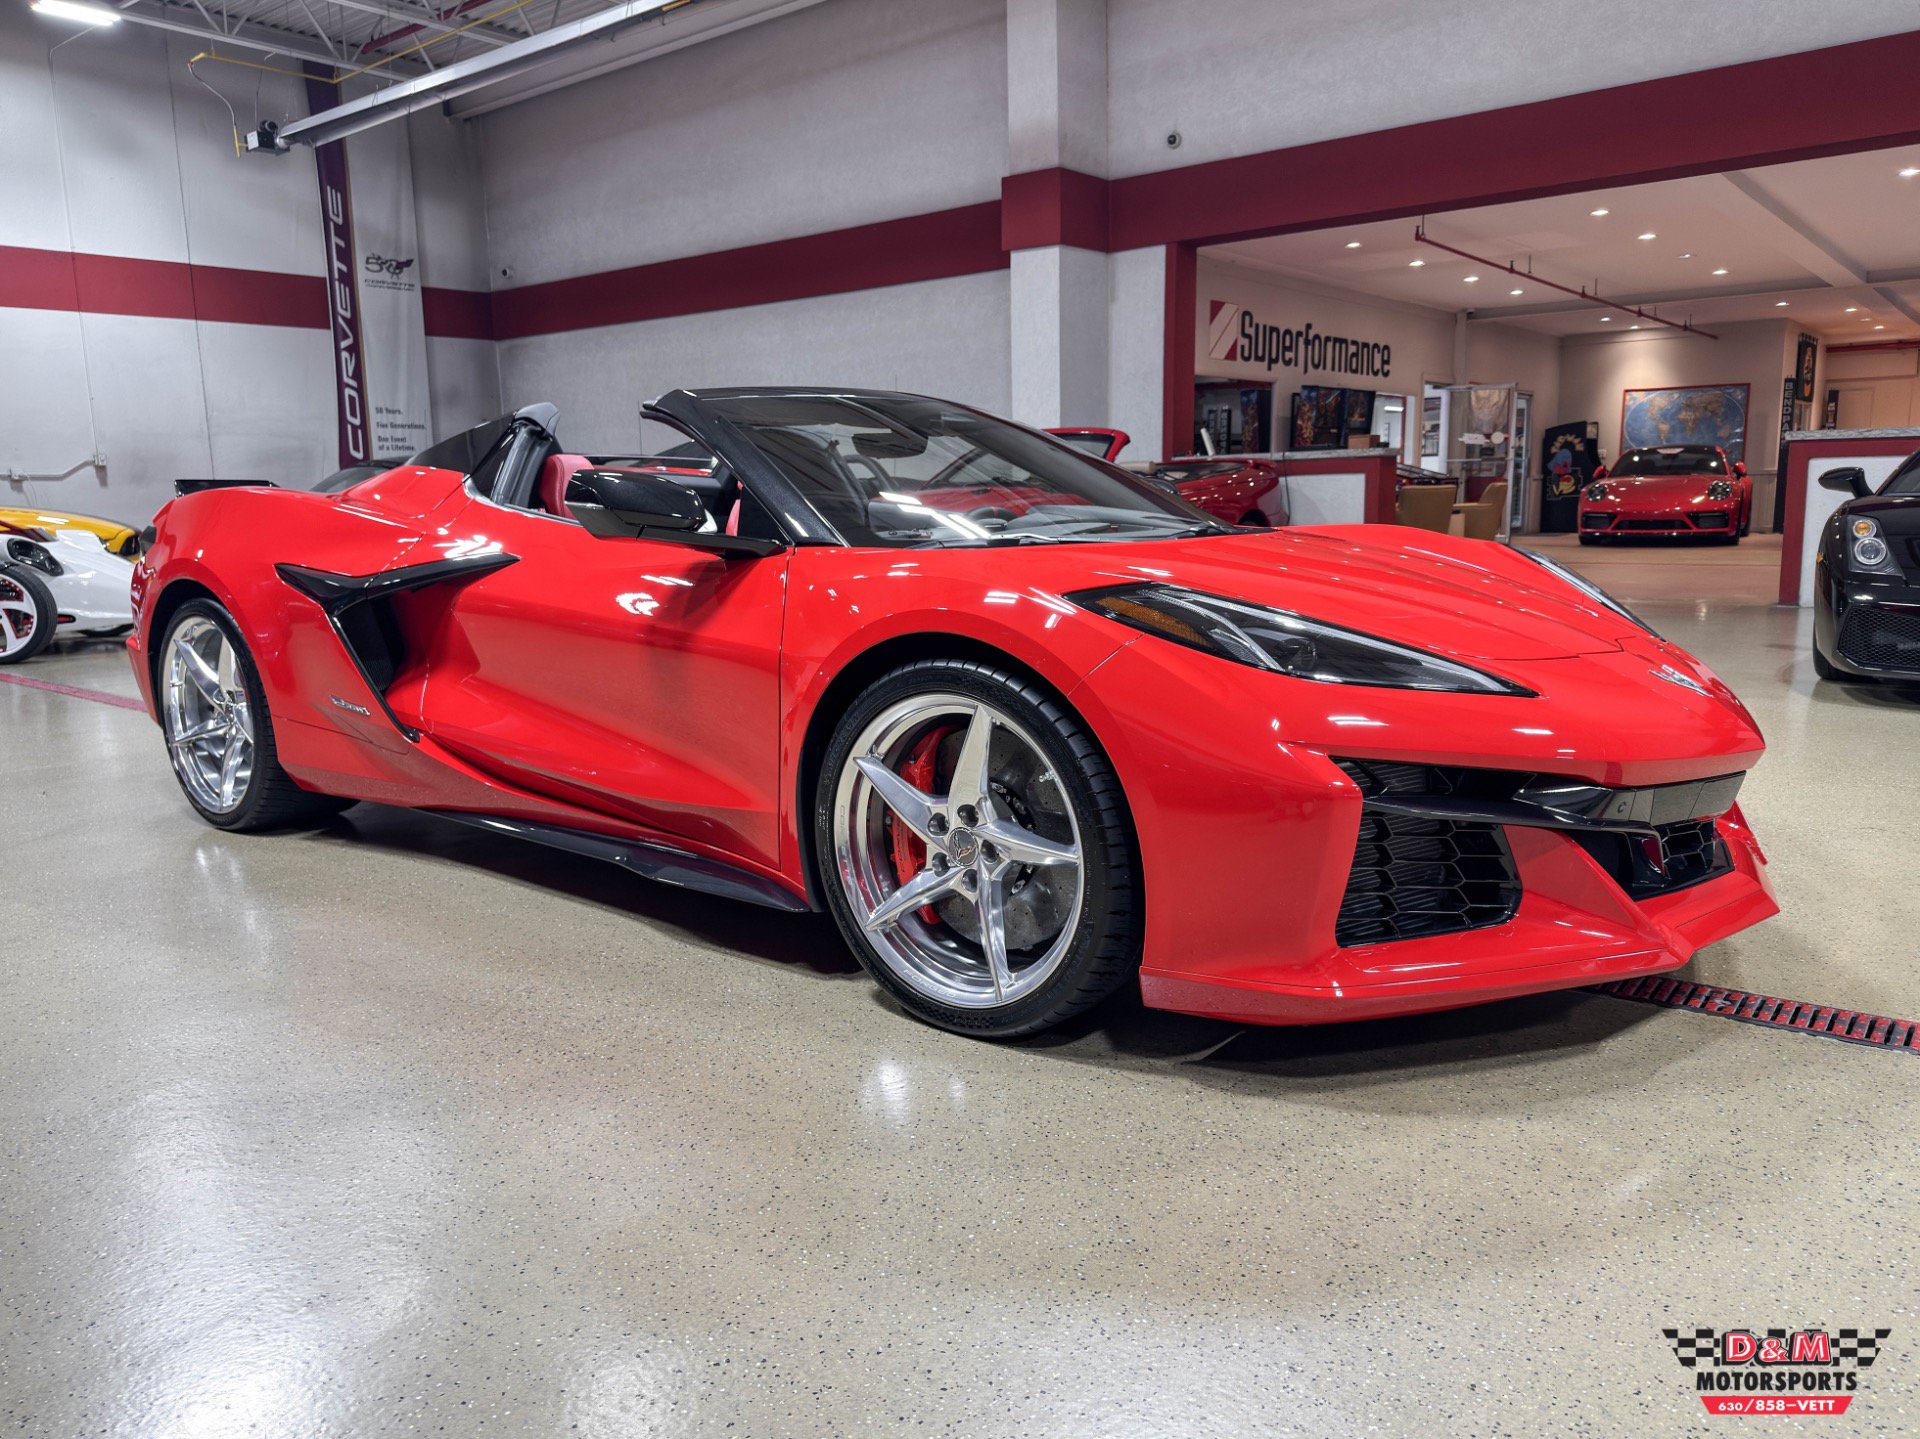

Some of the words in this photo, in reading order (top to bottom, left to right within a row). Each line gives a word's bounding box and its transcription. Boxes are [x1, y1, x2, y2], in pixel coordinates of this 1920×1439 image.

[327, 185, 363, 461] CORVETTE
[1240, 310, 1391, 377] Superformance
[1781, 381, 1794, 438] BENDPA
